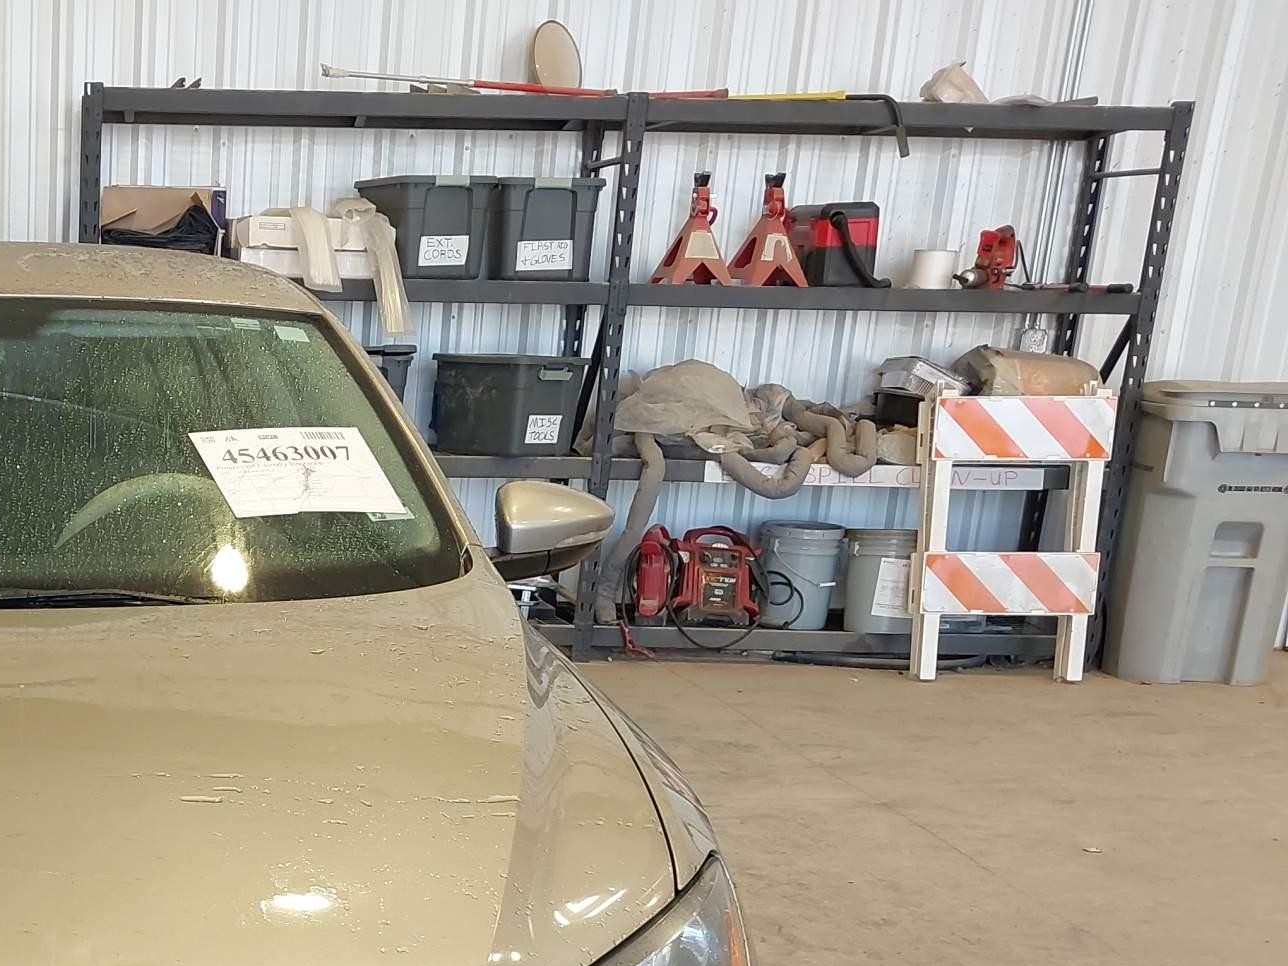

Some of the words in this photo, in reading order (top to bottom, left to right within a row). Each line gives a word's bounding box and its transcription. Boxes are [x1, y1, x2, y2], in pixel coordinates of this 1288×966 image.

[425, 237, 454, 248] EXT.
[523, 242, 554, 251] FIRST
[556, 241, 569, 250] AID
[423, 248, 462, 261] CORDS
[528, 416, 558, 428] MISC
[527, 430, 555, 441] TOOLS
[222, 445, 350, 464] 45463007
